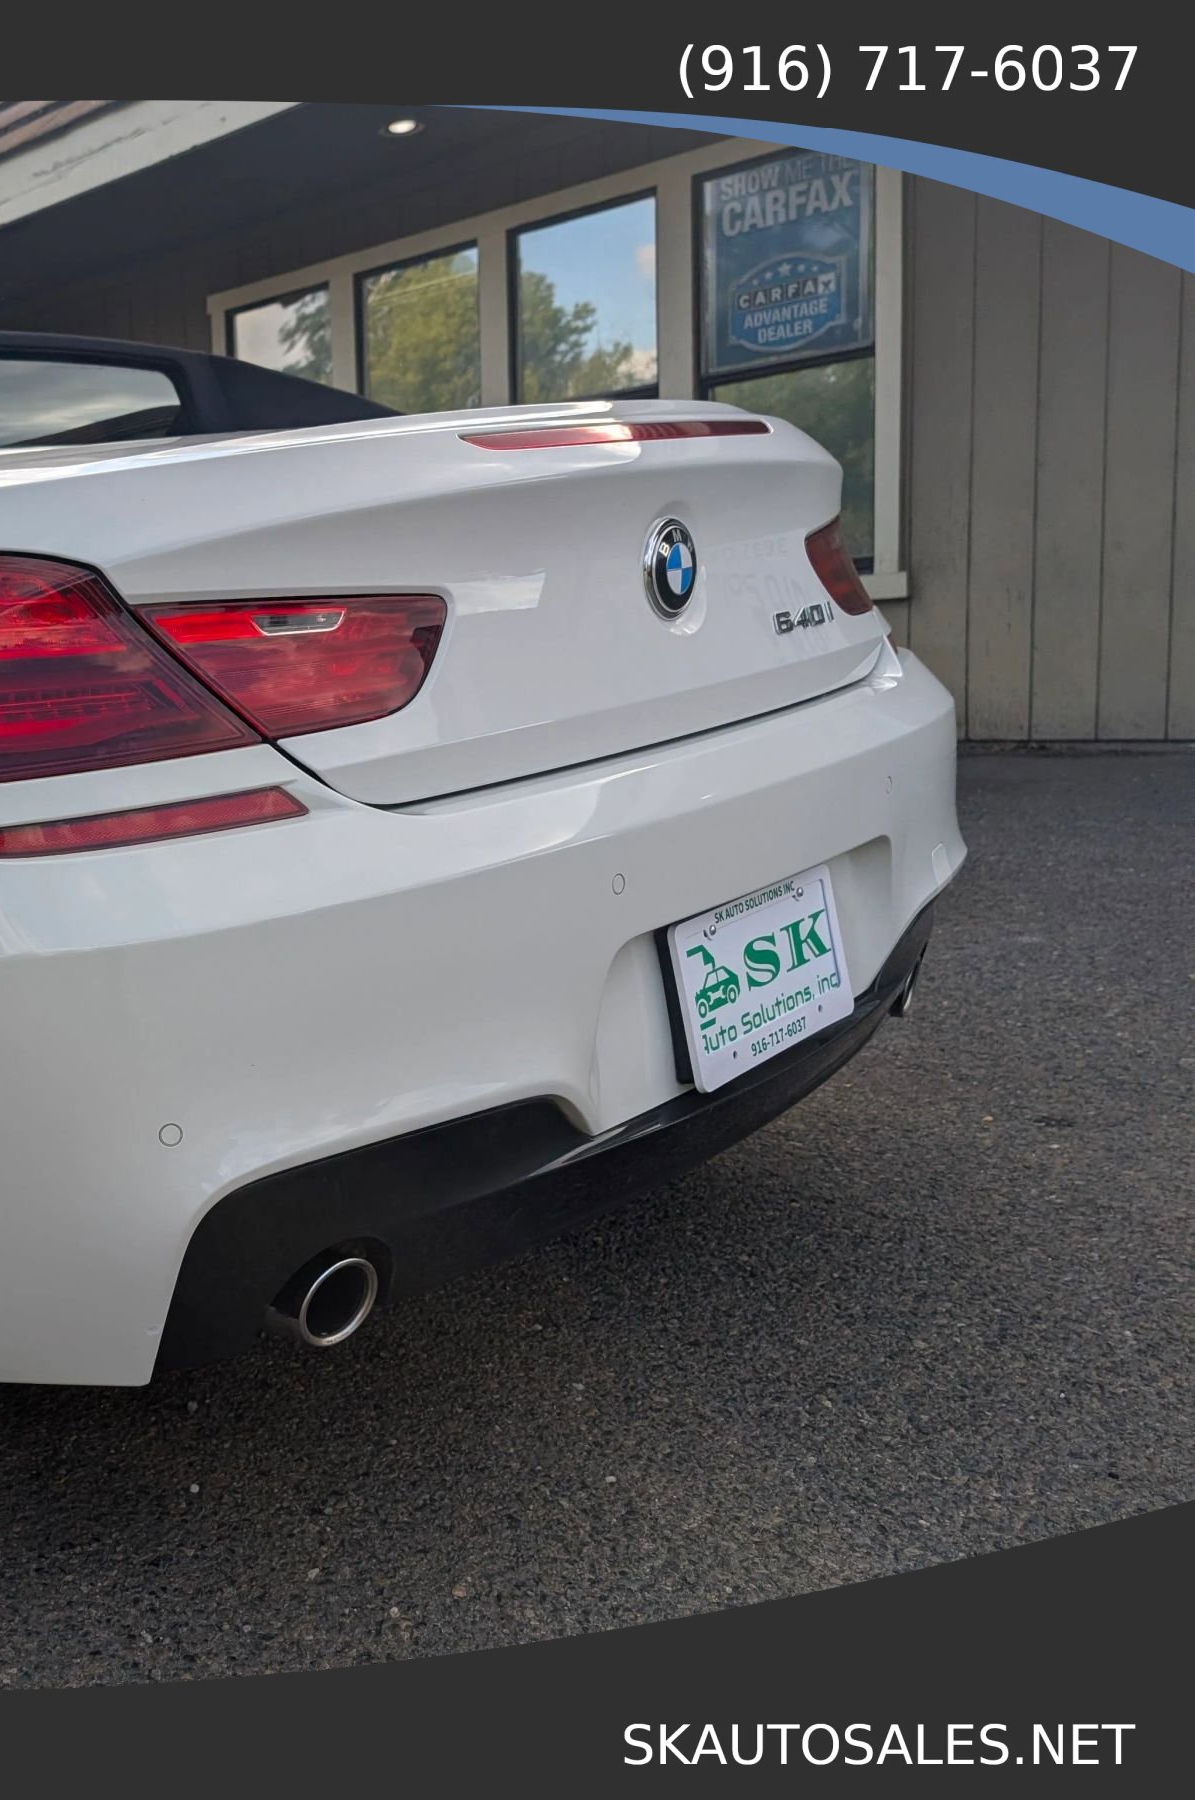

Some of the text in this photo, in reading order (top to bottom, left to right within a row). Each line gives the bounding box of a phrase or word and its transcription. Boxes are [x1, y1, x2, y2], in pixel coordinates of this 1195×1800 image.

[721, 166, 780, 200] SHOW
[784, 157, 812, 182] ME
[722, 171, 853, 238] CARFAX
[738, 273, 836, 310] CARFAX
[744, 298, 828, 329] ADVANTAGE
[758, 319, 813, 343] DEALER
[714, 880, 796, 924] SK AUTO SOLUTIONS INC
[743, 908, 832, 992] SK
[741, 985, 815, 1035] Solutions,
[816, 972, 838, 995] inc
[751, 1017, 807, 1057] 916-717-6037
